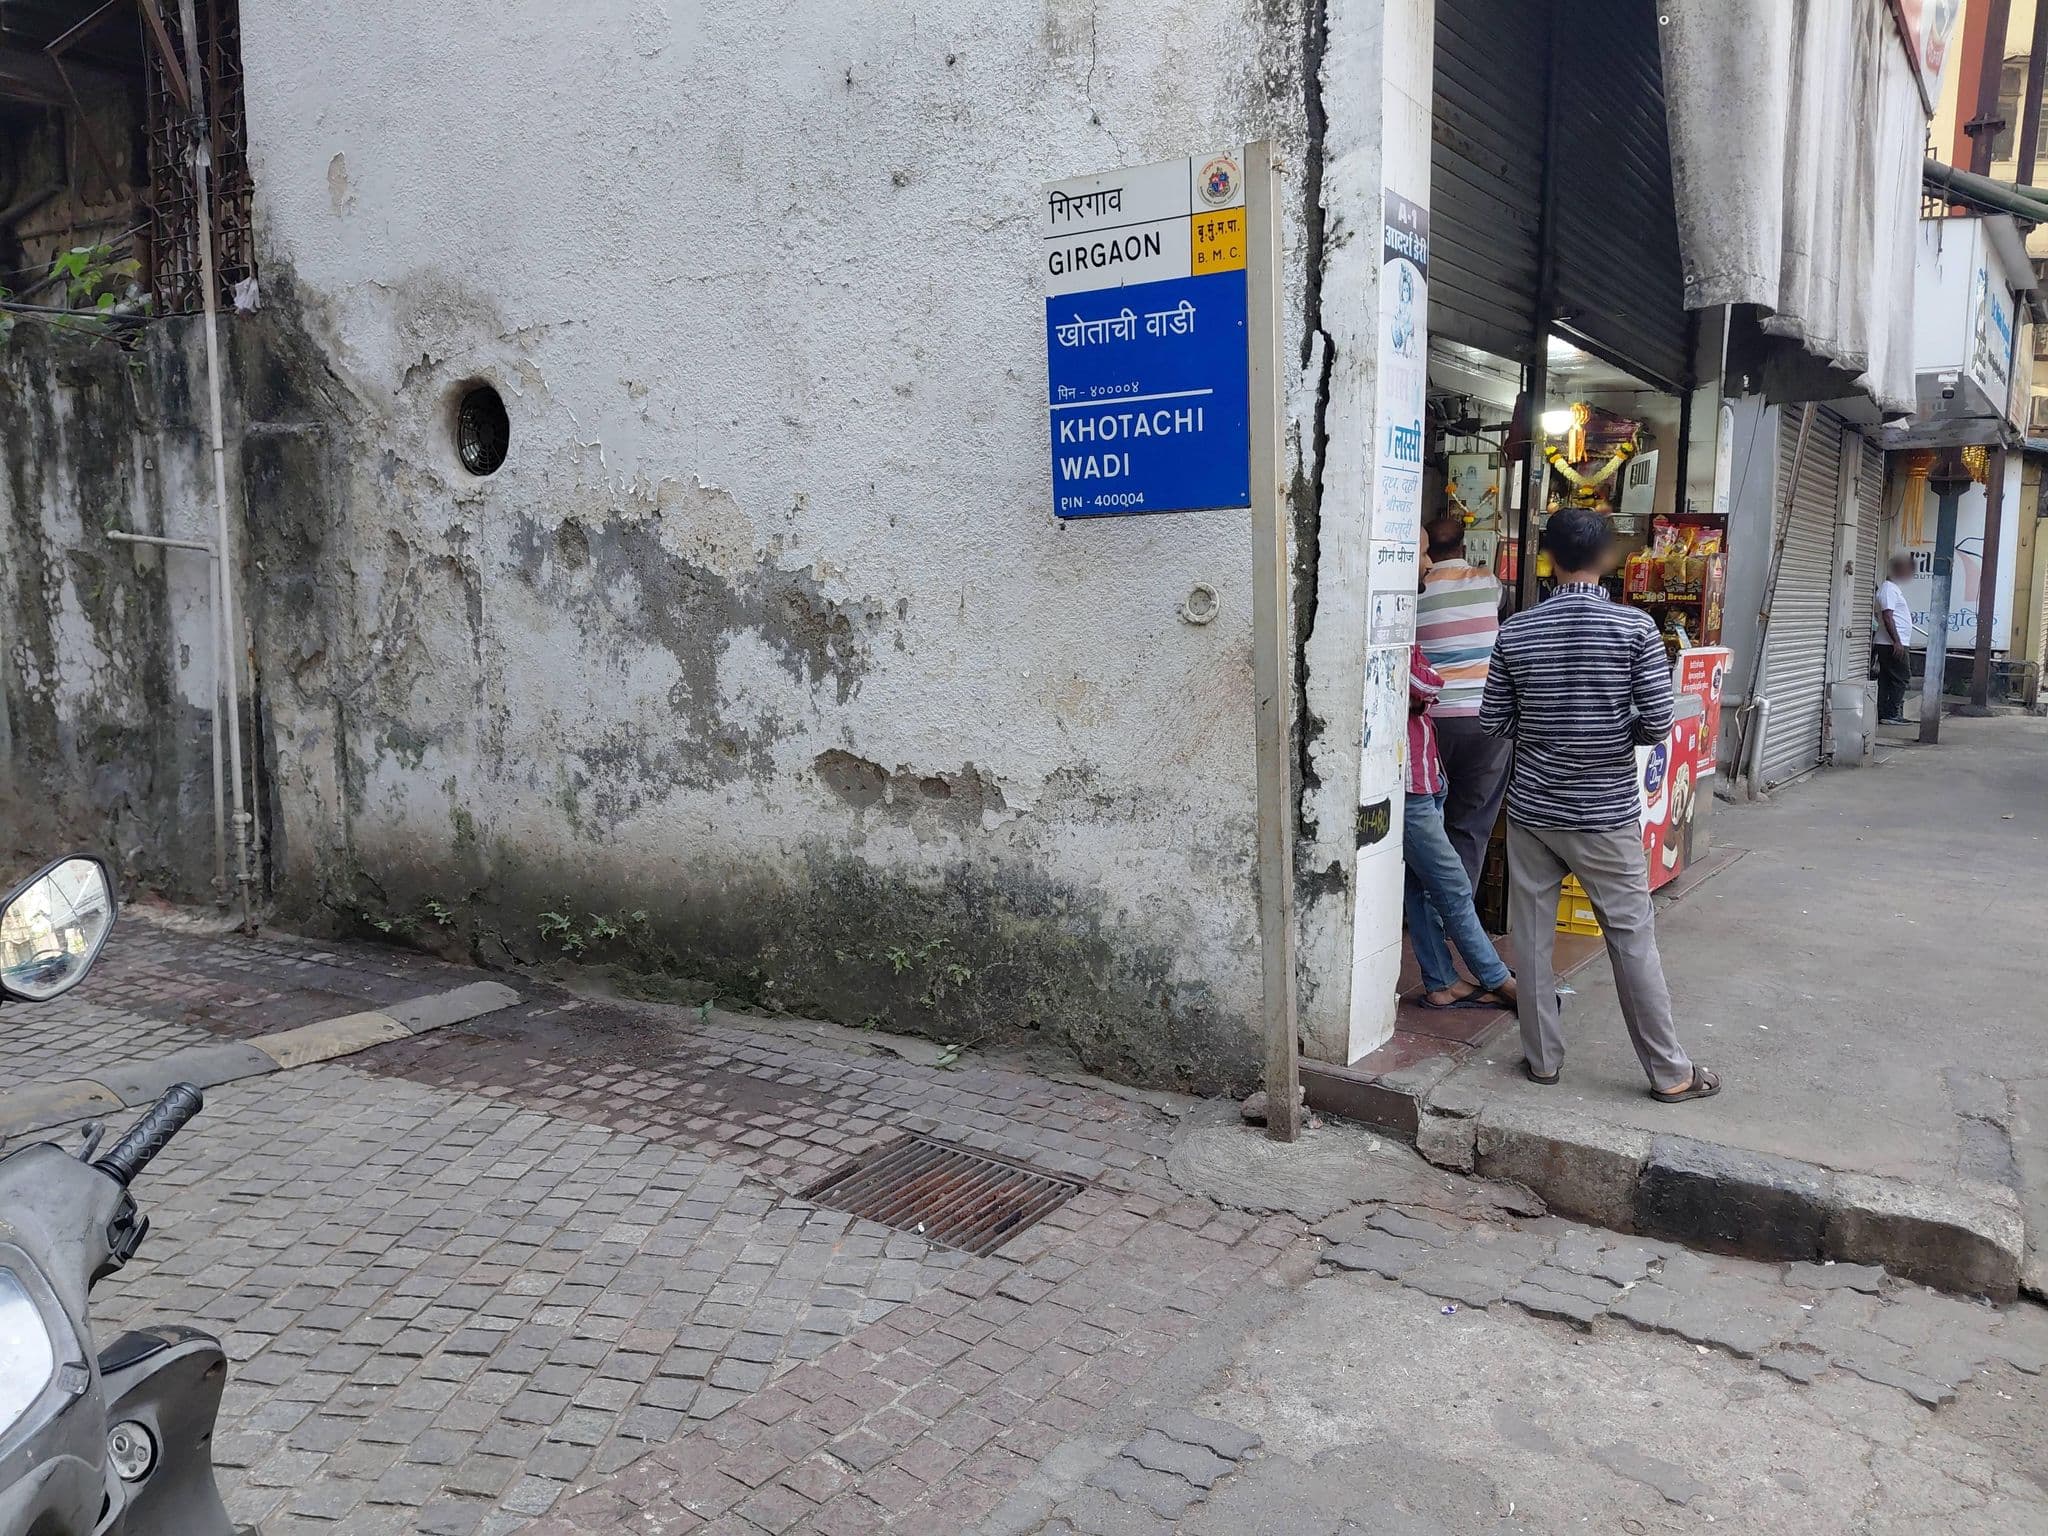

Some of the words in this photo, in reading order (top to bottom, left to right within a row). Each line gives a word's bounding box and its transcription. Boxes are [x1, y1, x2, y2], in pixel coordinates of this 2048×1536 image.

[1049, 187, 1123, 225] गिरगाव
[1048, 232, 1161, 276] GIRGAON
[1055, 308, 1137, 347] खोताची
[1144, 300, 1197, 337] वाडी
[1057, 385, 1076, 400] पिन
[1090, 381, 1140, 398] ४००००४
[1060, 407, 1204, 444] KHOTACHI
[1394, 419, 1422, 463] लस्सी
[1060, 453, 1130, 481] WADI
[1401, 474, 1417, 494] दही
[1061, 496, 1083, 510] PIN
[1094, 492, 1145, 508] 400004
[1377, 546, 1395, 565] ग्रीन
